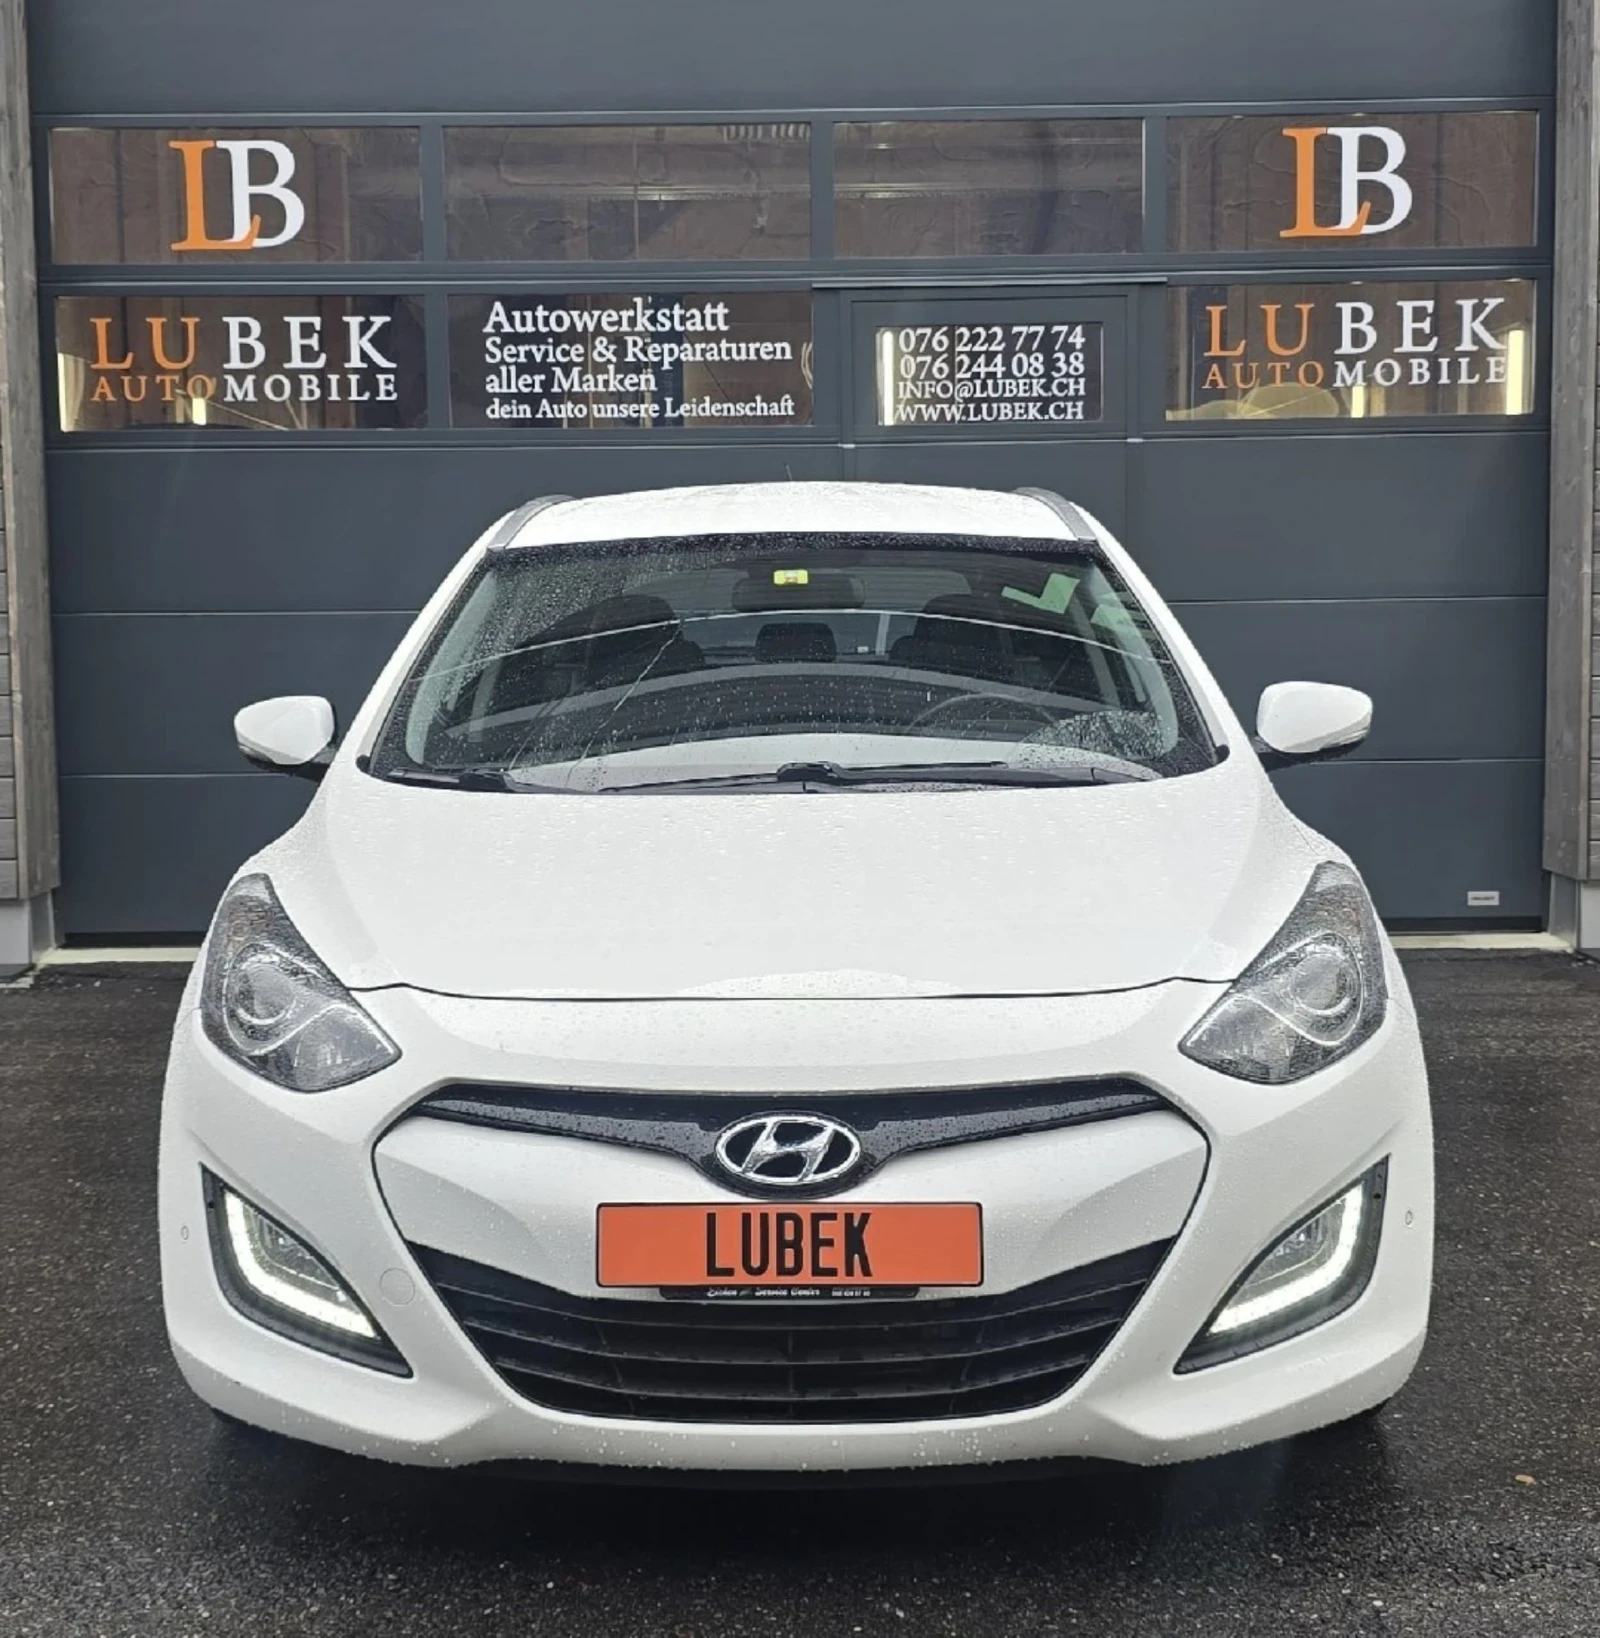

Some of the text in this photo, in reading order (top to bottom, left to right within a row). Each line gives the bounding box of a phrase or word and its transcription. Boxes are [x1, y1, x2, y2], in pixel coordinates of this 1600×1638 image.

[169, 139, 305, 251] LB
[1279, 125, 1413, 238] LB
[482, 296, 730, 334] Autowerkstatt
[899, 324, 1086, 352] 076 222 77 74
[484, 335, 793, 371] Service & Reparaturen
[900, 351, 1085, 380] 076 244 08 38
[485, 366, 546, 393] aller
[551, 364, 658, 393] Marken
[1201, 356, 1507, 390] AUTOMOBILE
[90, 374, 398, 403] AUTOMOBILE
[898, 377, 1086, 402] INFO@LUBEK.CH
[486, 393, 796, 419] dein Auto unsere Leidenschaft
[895, 401, 1085, 422] WWW.LUBEK.CH
[705, 1212, 873, 1278] LUBEK
